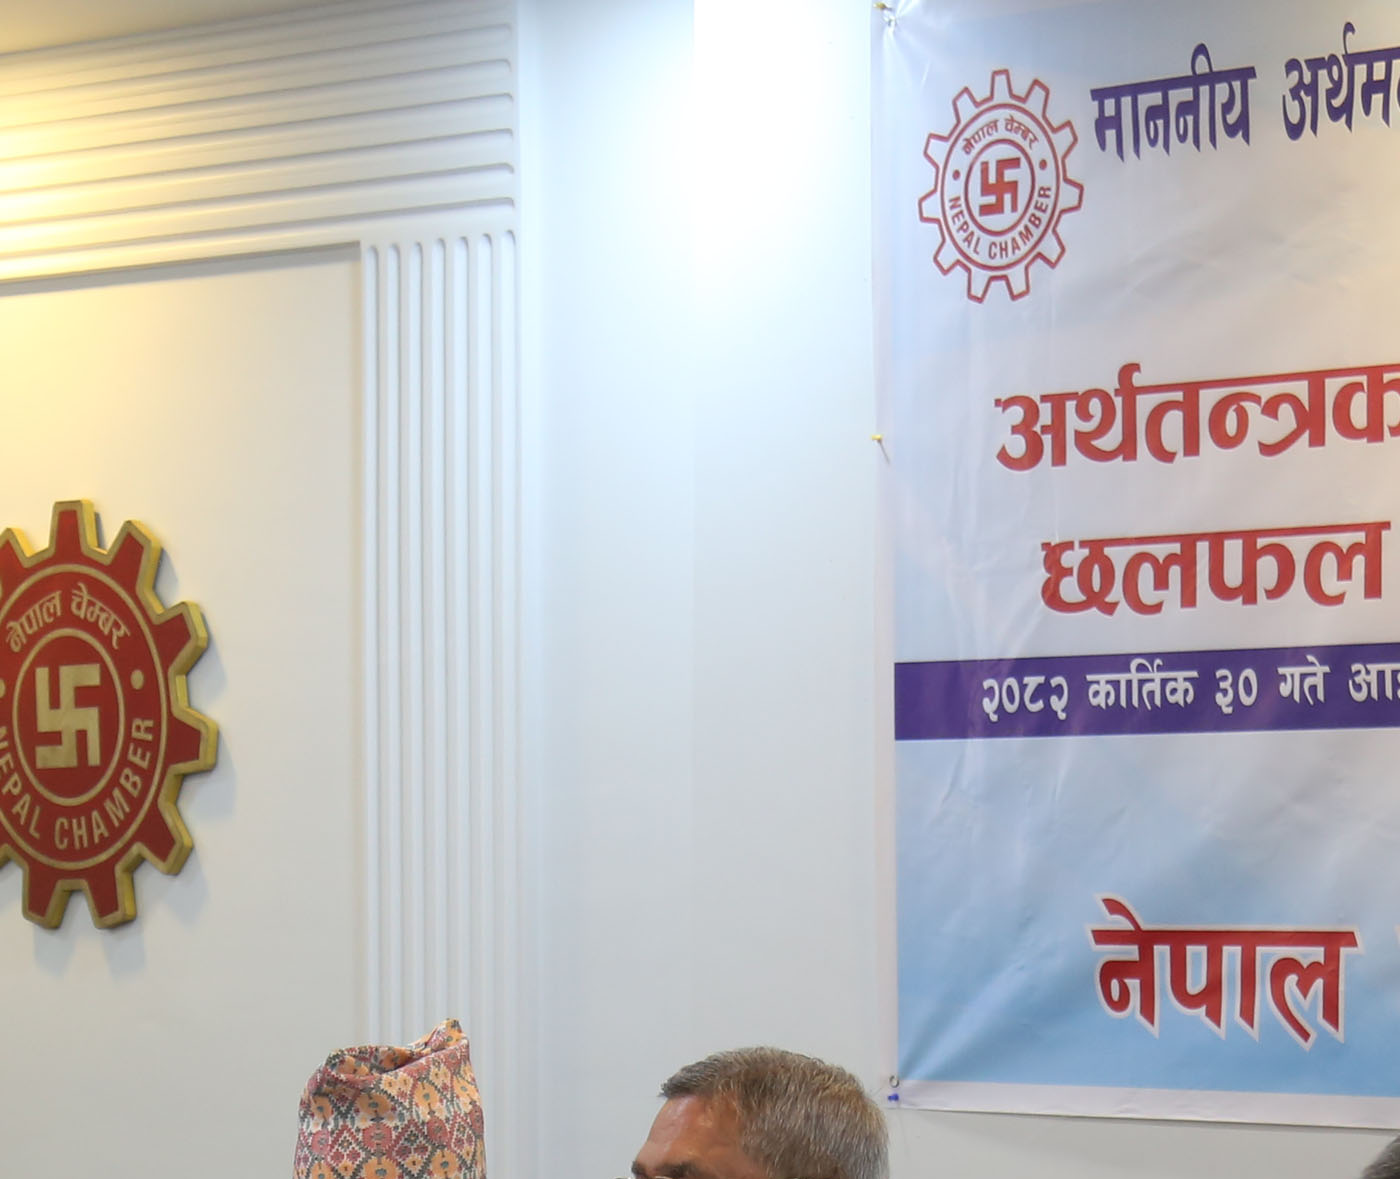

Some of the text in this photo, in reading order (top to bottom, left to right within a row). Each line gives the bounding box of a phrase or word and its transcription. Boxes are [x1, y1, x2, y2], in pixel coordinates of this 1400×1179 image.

[961, 114, 1040, 156] नेपाल चेम्बर
[1090, 43, 1257, 161] माननीय
[948, 186, 1052, 260] NEPAL CHAMBER
[1041, 520, 1391, 617] छलफल
[5, 582, 132, 653] नेपाल चेम्बर
[980, 675, 1069, 724] २०८२
[1086, 653, 1200, 711] कार्तिक
[1214, 667, 1260, 715] ३०
[1277, 651, 1330, 707] गते
[54, 717, 155, 850] CHAMBER
[1090, 896, 1360, 1046] नेपाल
